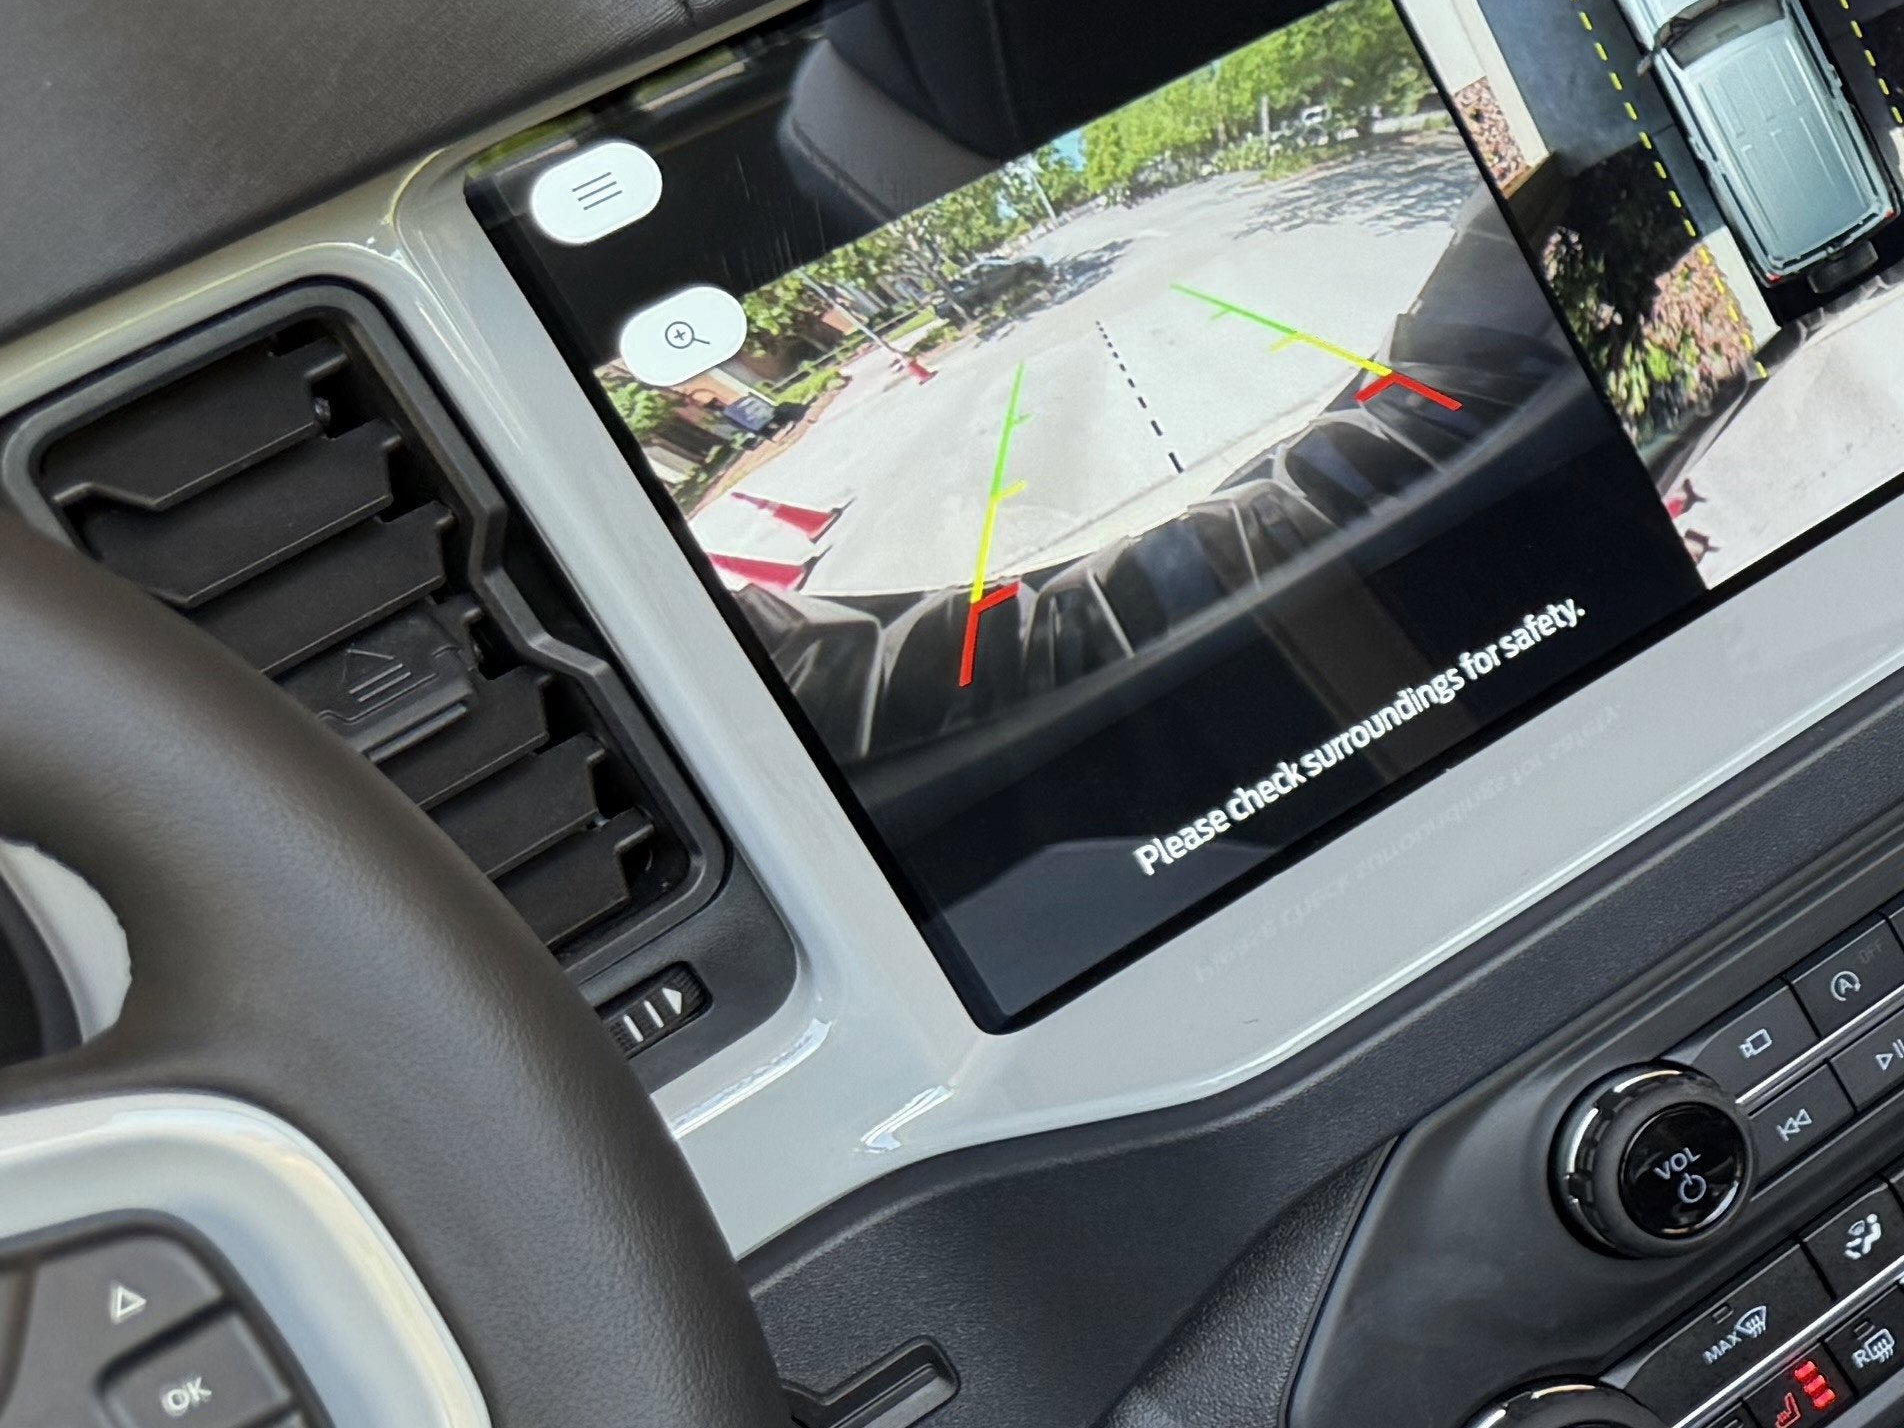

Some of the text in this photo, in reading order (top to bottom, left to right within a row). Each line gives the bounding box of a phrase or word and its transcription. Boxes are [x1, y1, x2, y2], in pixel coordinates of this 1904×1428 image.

[1133, 595, 1587, 877] Please check surroundings for safety.
[1655, 1147, 1701, 1181] VOL
[1702, 1329, 1743, 1366] MAX
[160, 1374, 213, 1418] OK
